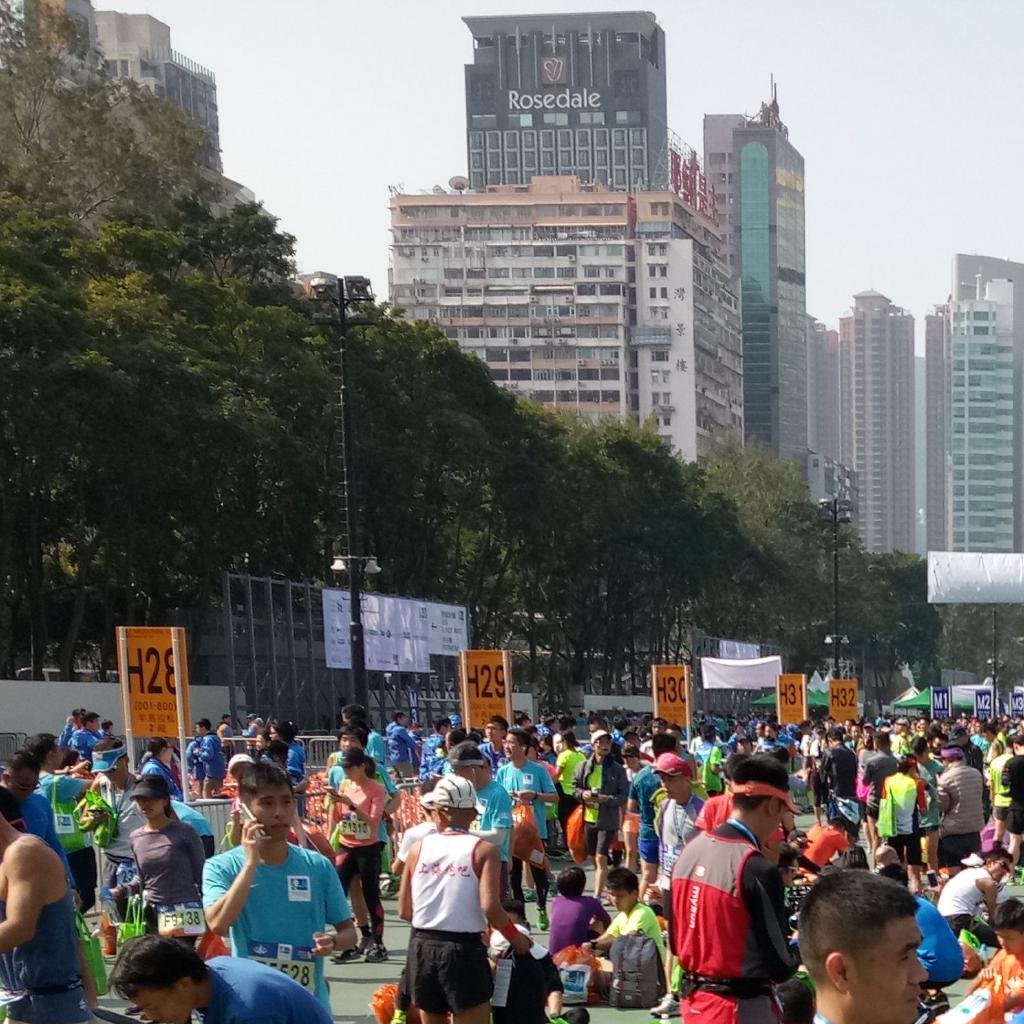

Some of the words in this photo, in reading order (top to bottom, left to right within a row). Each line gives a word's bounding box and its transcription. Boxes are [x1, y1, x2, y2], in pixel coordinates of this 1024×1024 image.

[508, 88, 601, 110] Rosedale
[127, 647, 177, 695] H28
[467, 664, 505, 698] H29
[657, 677, 686, 704] H30
[780, 684, 803, 706] H31
[831, 688, 856, 708] H32
[934, 693, 948, 710] M1
[977, 695, 991, 710] M2
[1011, 697, 1023, 711] M3
[164, 911, 200, 928] F9138
[265, 961, 310, 987] 528
